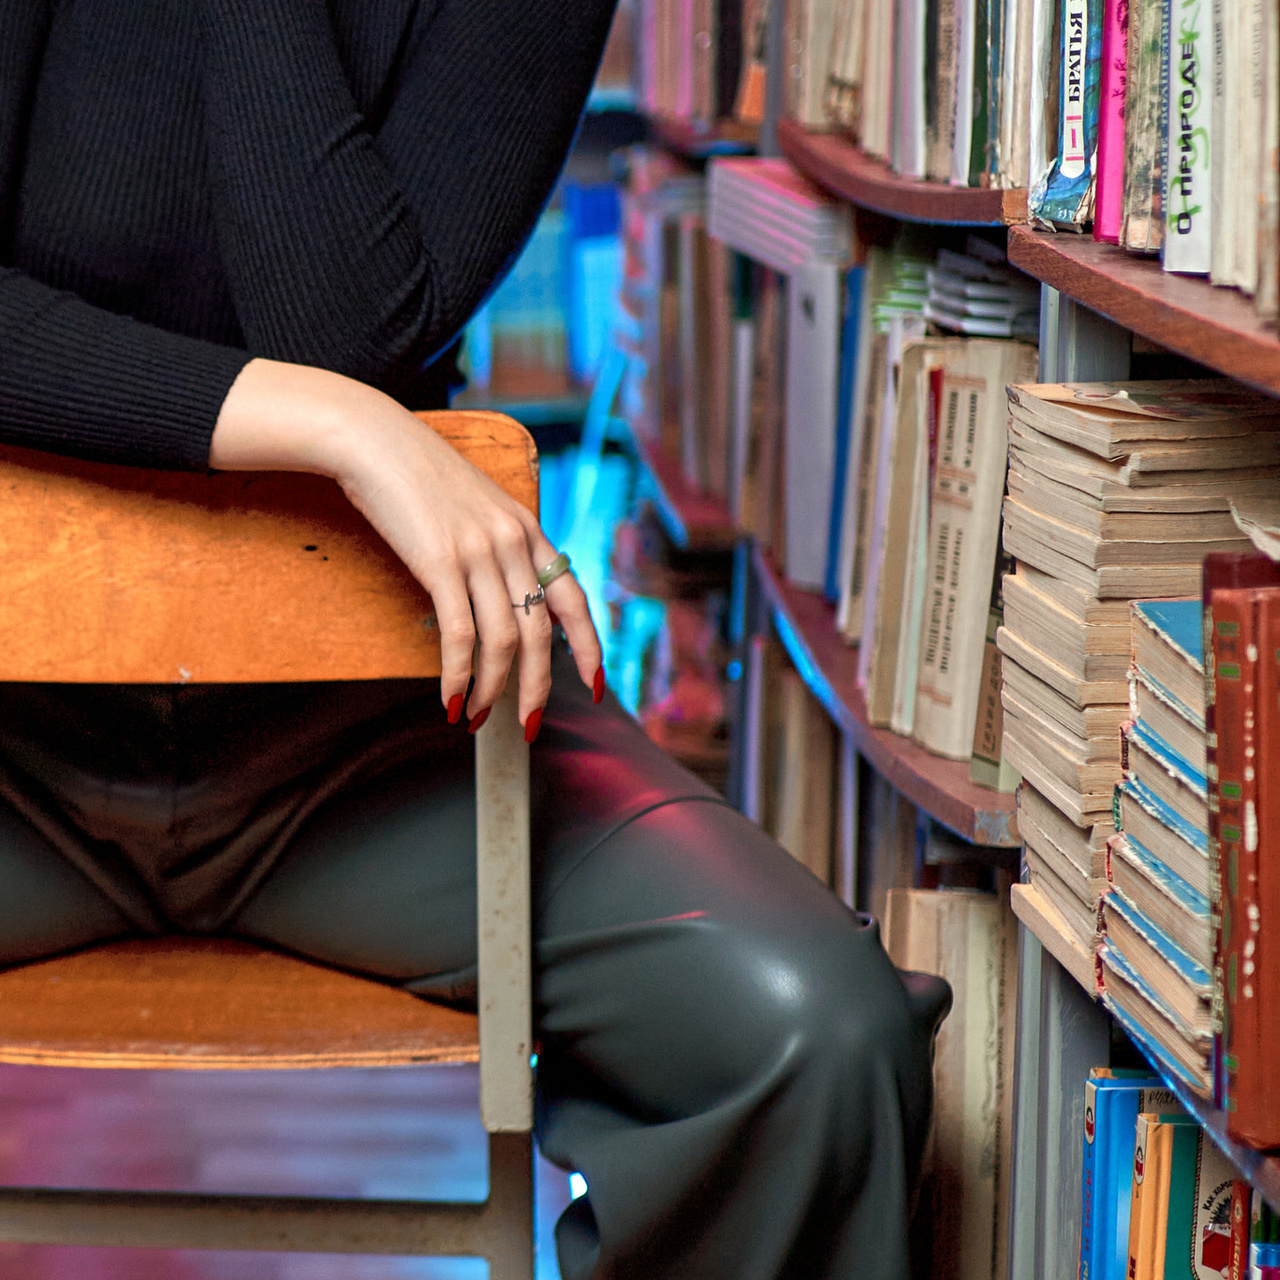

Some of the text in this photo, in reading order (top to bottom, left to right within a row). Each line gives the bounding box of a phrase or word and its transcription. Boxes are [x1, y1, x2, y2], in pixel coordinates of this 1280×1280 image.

[1068, 11, 1083, 103] БРАТЬЯ
[1251, 23, 1261, 99] РУССКИЕ
[1177, 37, 1196, 236] О ПРИРОДЕ
[1202, 1195, 1216, 1211] КАК
